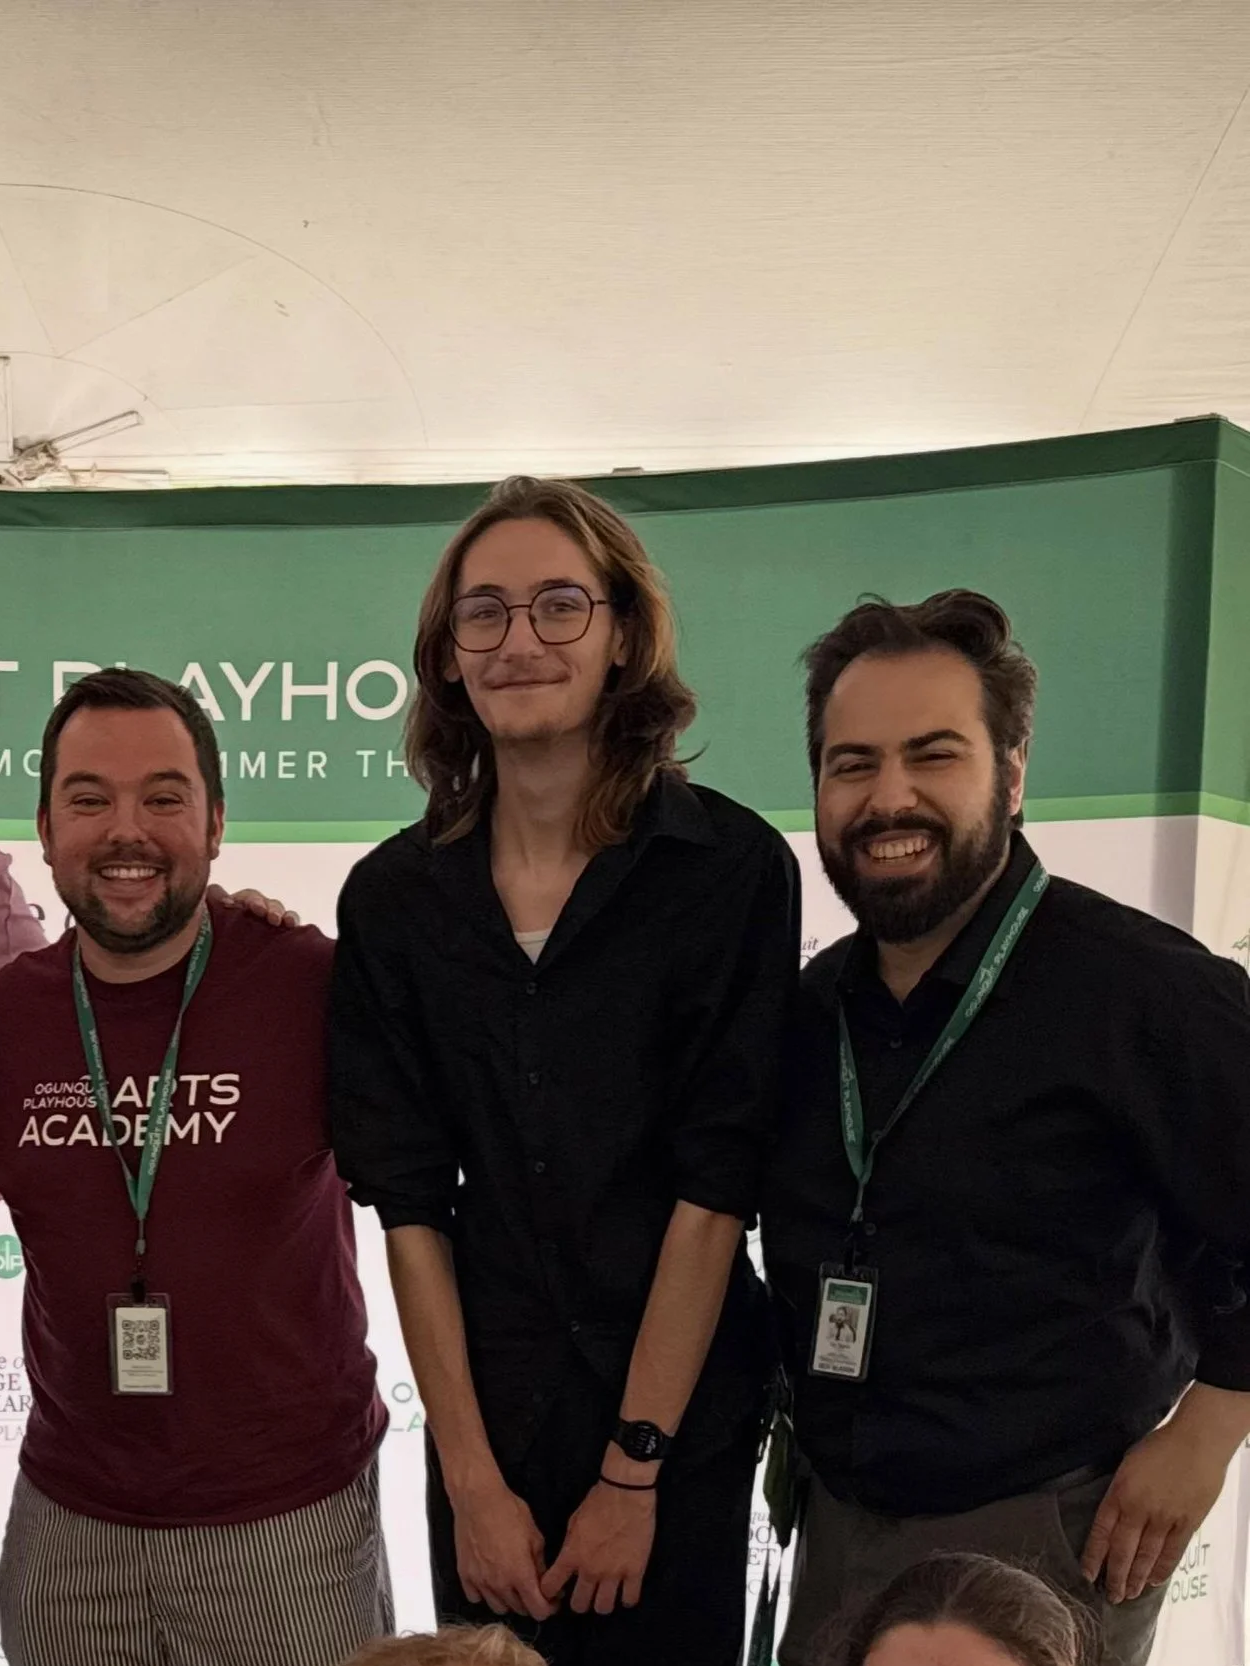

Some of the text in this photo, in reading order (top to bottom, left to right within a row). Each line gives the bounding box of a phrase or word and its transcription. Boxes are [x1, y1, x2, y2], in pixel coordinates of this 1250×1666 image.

[34, 1081, 95, 1097] OGUNQU
[23, 1096, 98, 1111] PLAYHOUS
[18, 1111, 237, 1148] ACADEMY
